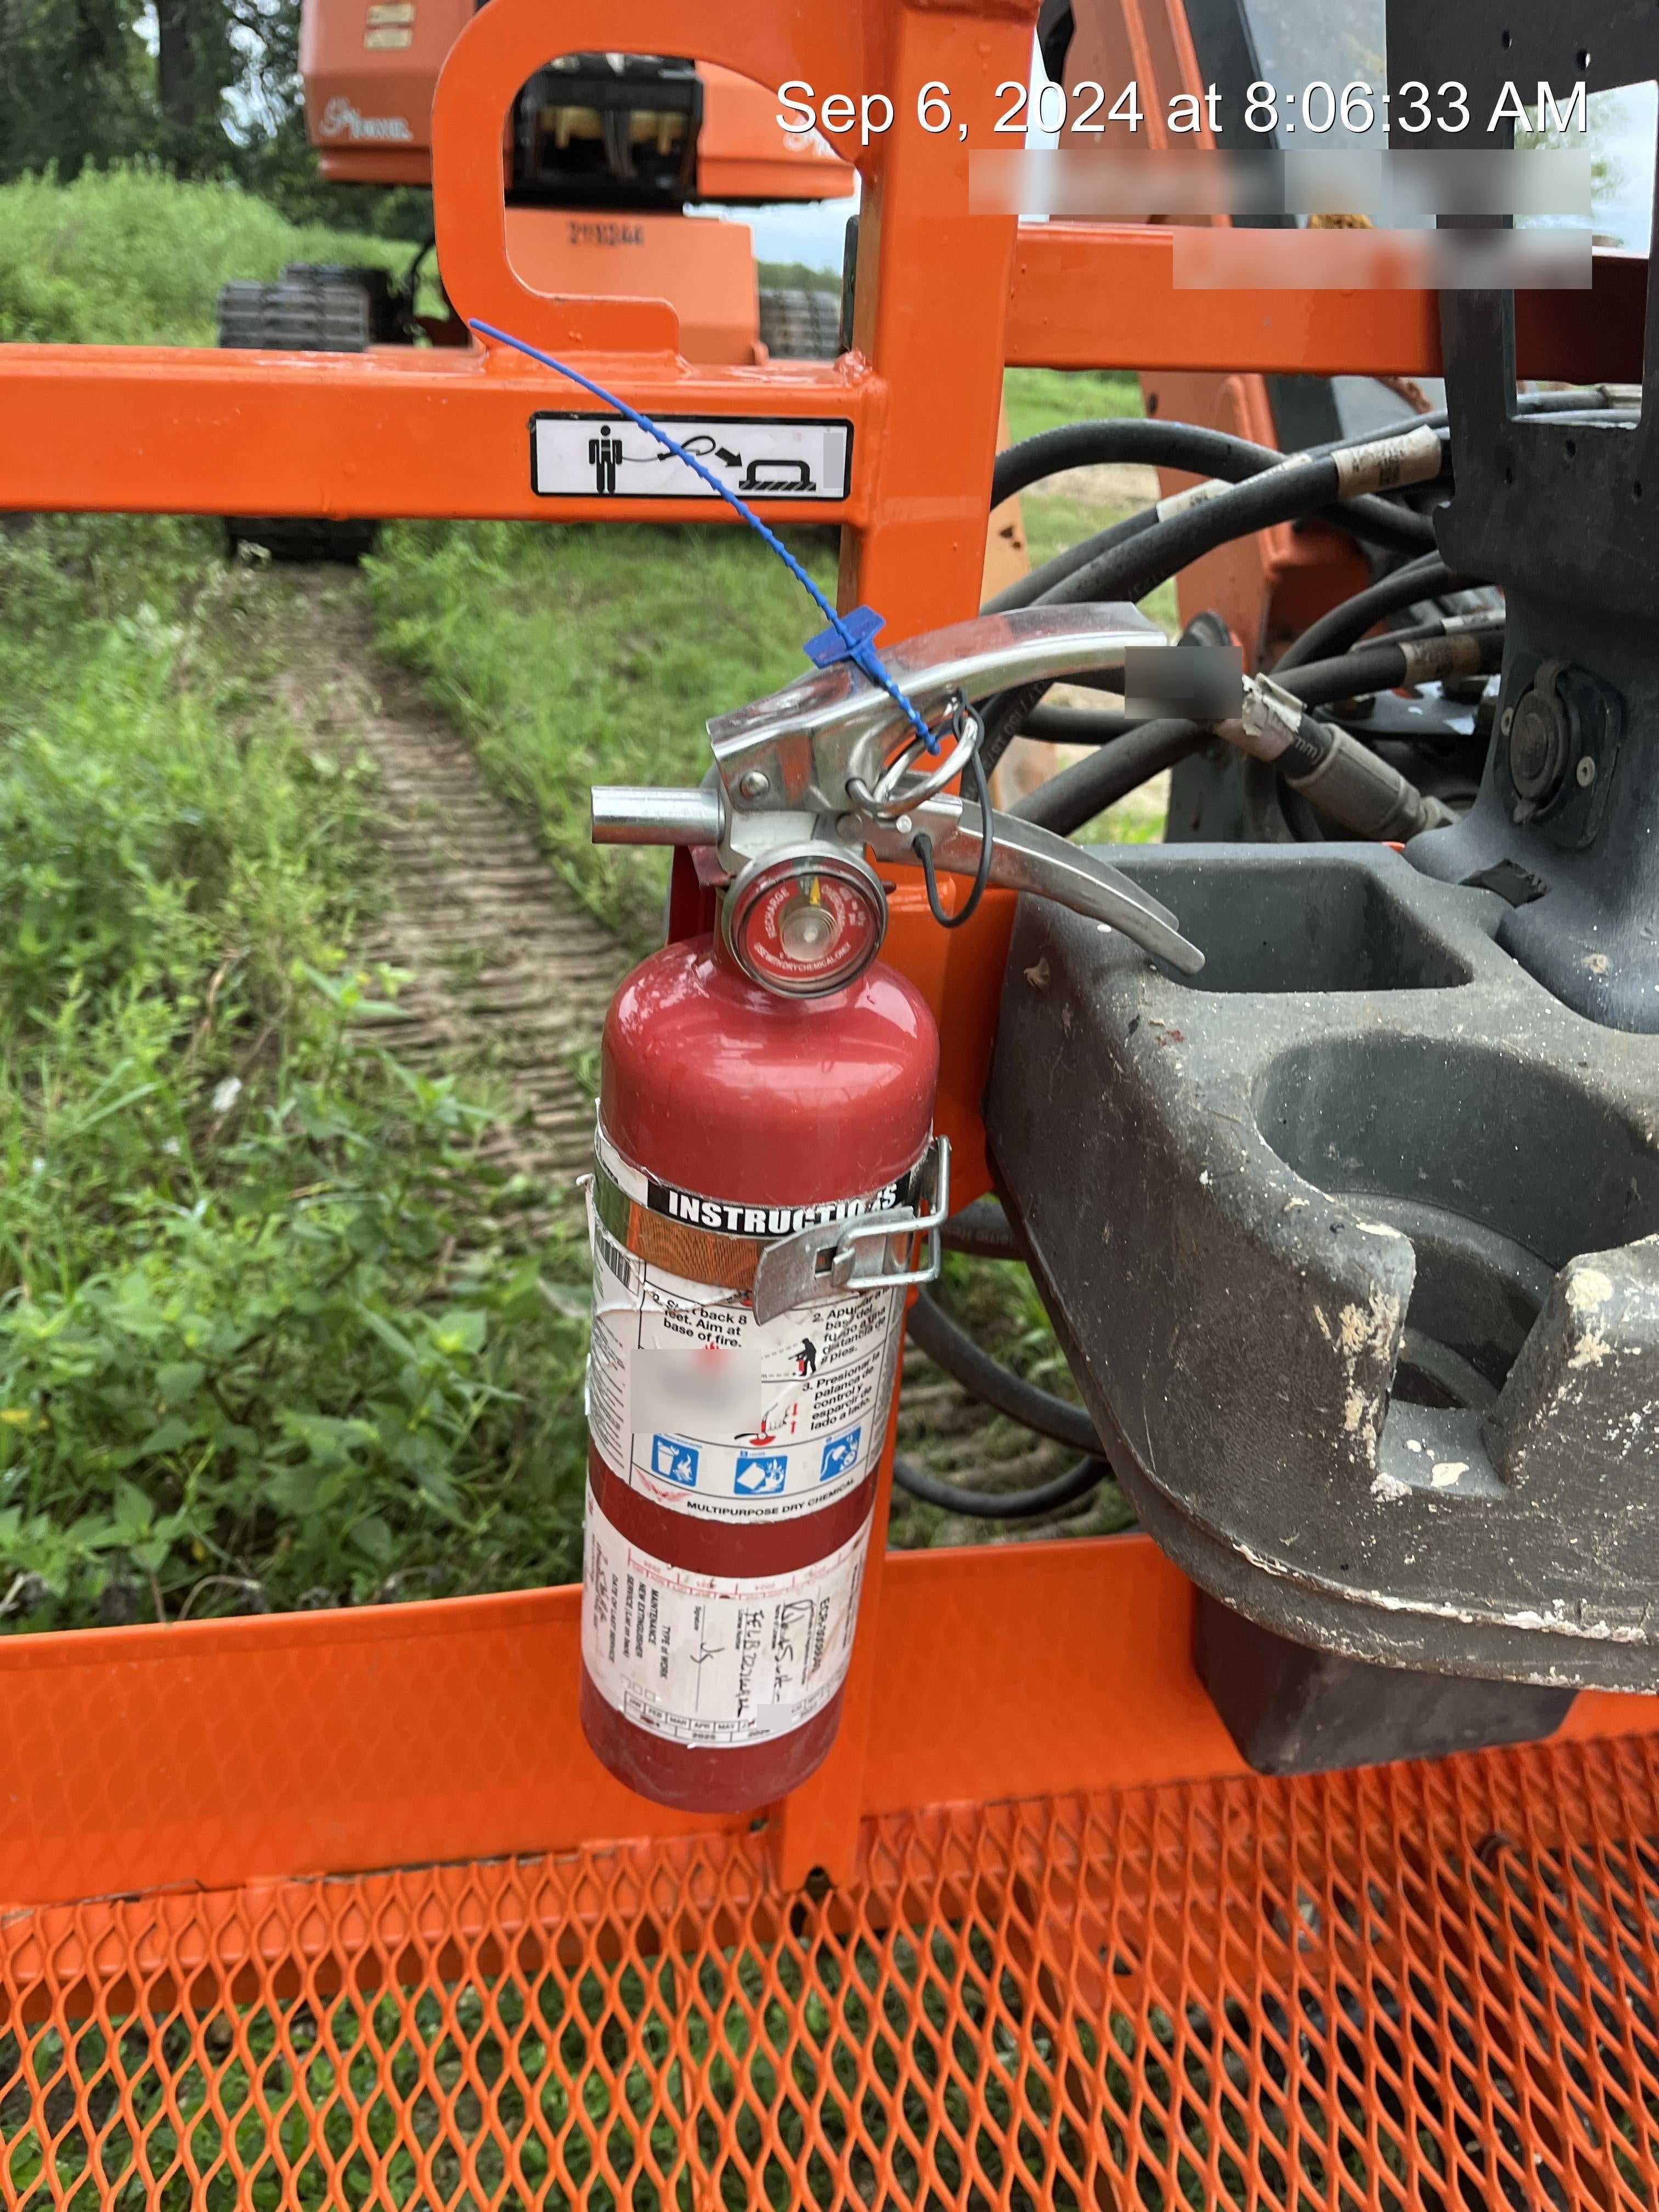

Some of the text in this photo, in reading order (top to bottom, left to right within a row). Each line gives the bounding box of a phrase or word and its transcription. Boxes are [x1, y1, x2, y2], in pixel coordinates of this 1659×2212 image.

[700, 1307, 735, 1324] back
[738, 1314, 747, 1325] 8
[664, 1317, 742, 1348] base of fire.
[696, 1318, 723, 1333] Aim
[727, 1326, 741, 1336] at
[802, 1381, 813, 1392] 3.
[813, 1386, 856, 1409] control
[810, 1415, 837, 1431] lado
[687, 1478, 854, 1516] MULTIPURPOSE DRY CHEMICAL
[648, 1588, 659, 1645] MAINTENANCE
[662, 1624, 671, 1645] TYPE
